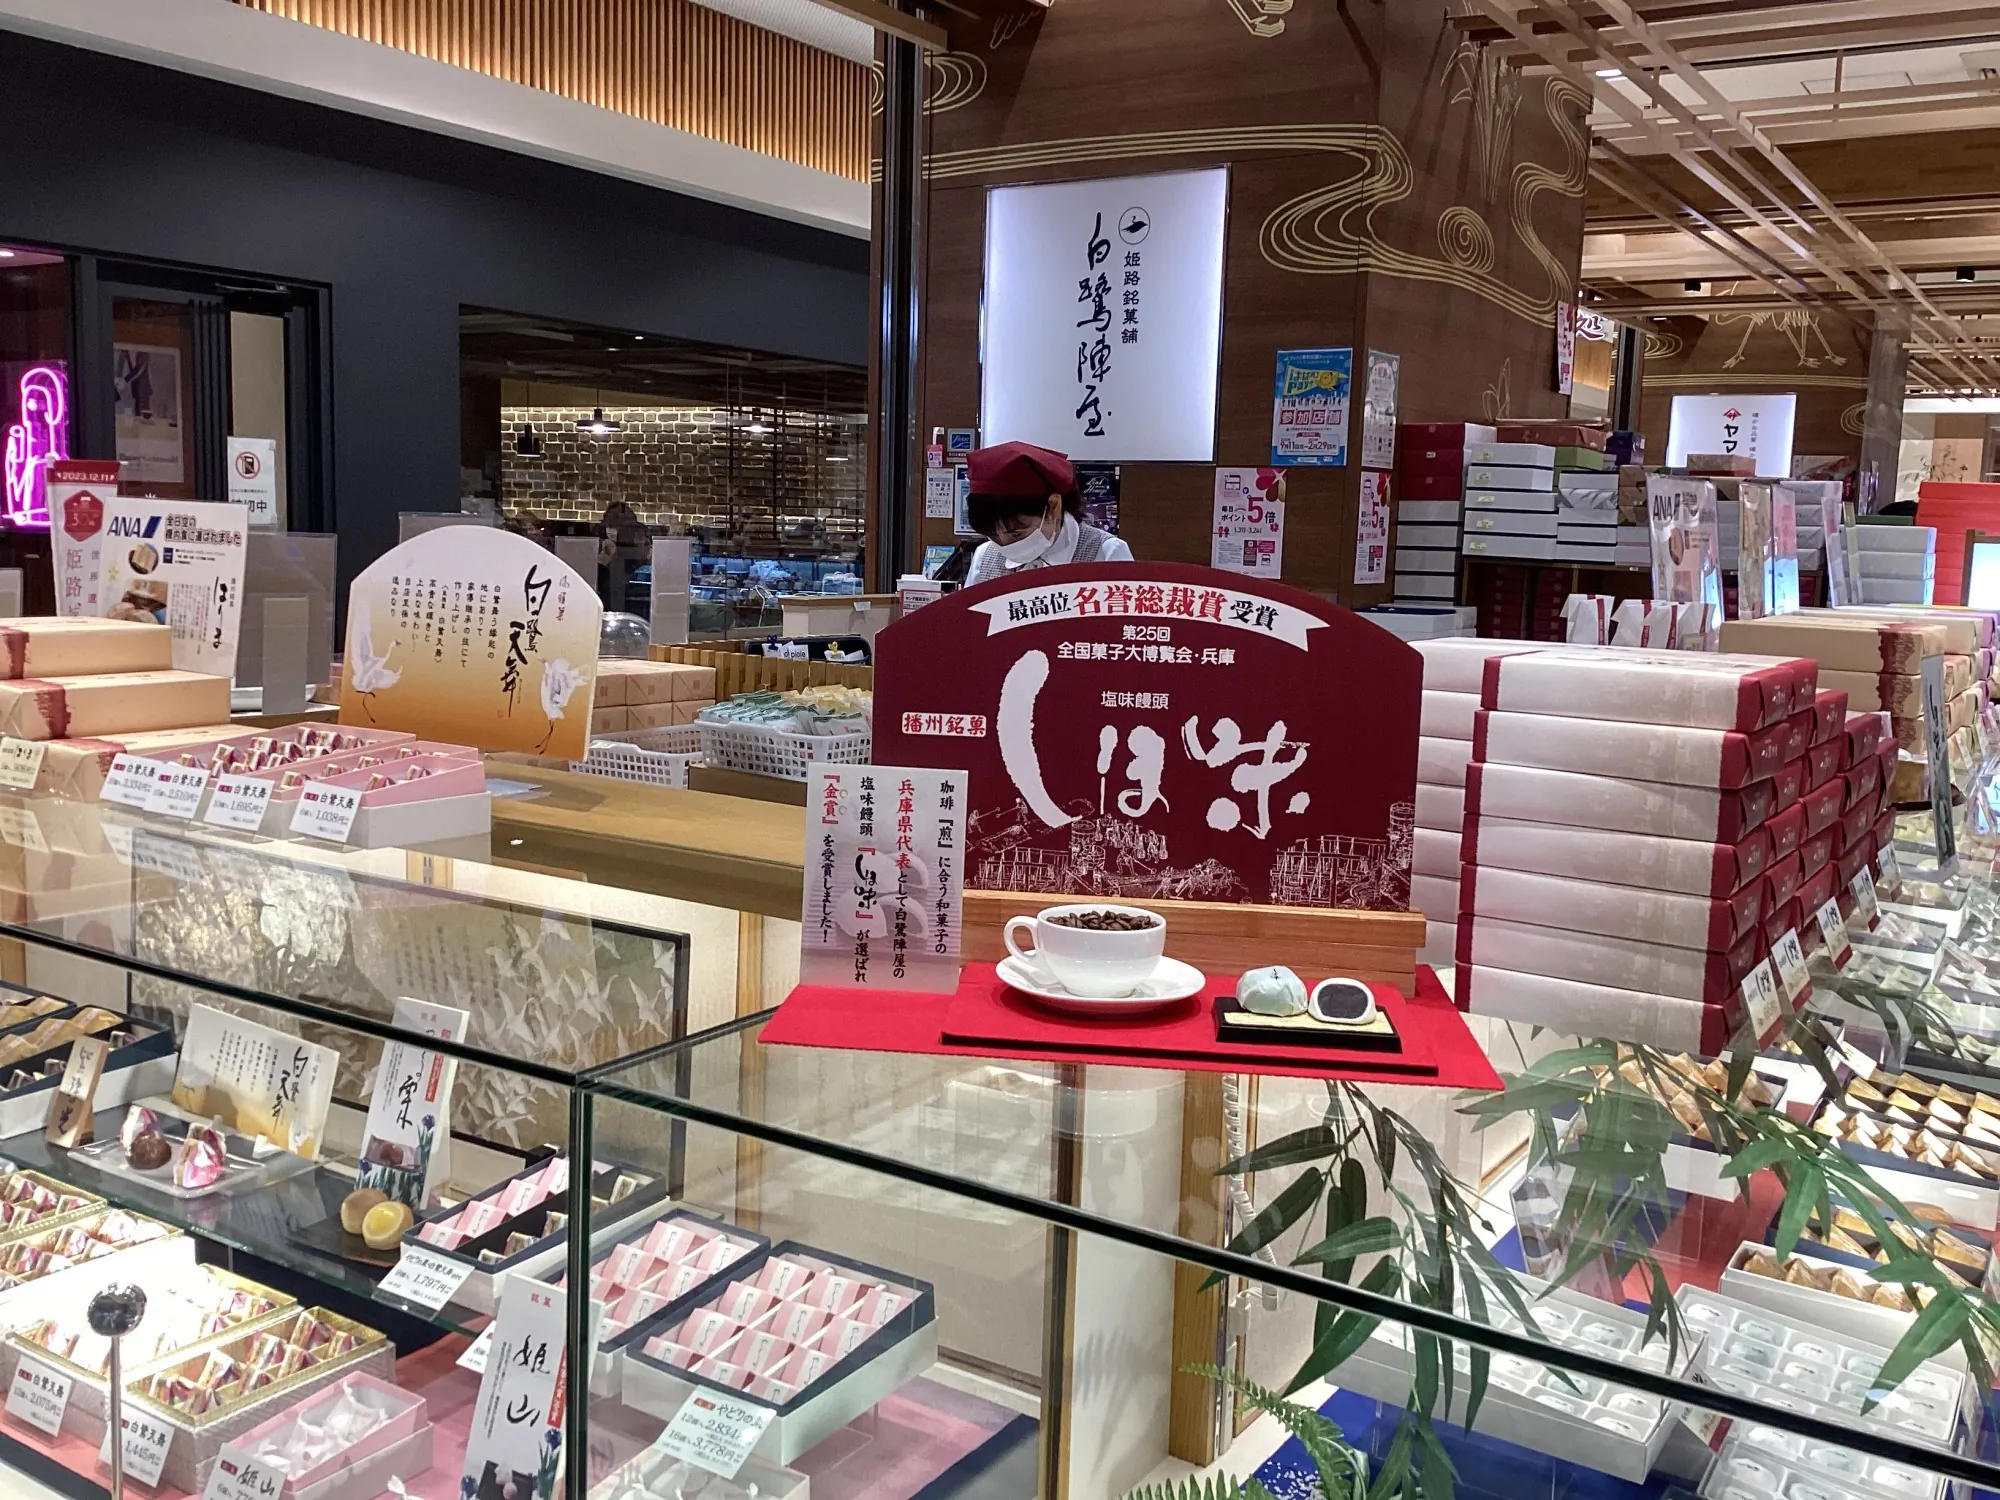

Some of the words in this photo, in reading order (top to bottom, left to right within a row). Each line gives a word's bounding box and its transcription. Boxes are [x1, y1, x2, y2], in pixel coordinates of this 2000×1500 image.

[1121, 251, 1140, 343] 姫路銘菓舗
[1075, 212, 1112, 436] 白鷺陣屋
[1280, 409, 1341, 425] 参加店舗
[166, 513, 197, 528] 全日空の
[1246, 496, 1264, 524] 5
[107, 516, 142, 538] ANA
[164, 528, 242, 547] 機内食に選ばれました
[1007, 584, 1280, 632] 最高位名誉総裁賞受賞
[1122, 624, 1171, 642] 第25回
[1057, 641, 1236, 666] 全国菓子大博覧会・兵庫
[1100, 690, 1170, 710] 塩味饅頭
[903, 713, 987, 736] 播州銘菓
[996, 649, 1311, 840] しほ味
[233, 784, 267, 799] 白鷺天舞
[320, 792, 355, 810] 白鷺天舞
[33, 1374, 65, 1399] 白鷺天舞
[130, 1420, 167, 1448] 白鷺天舞
